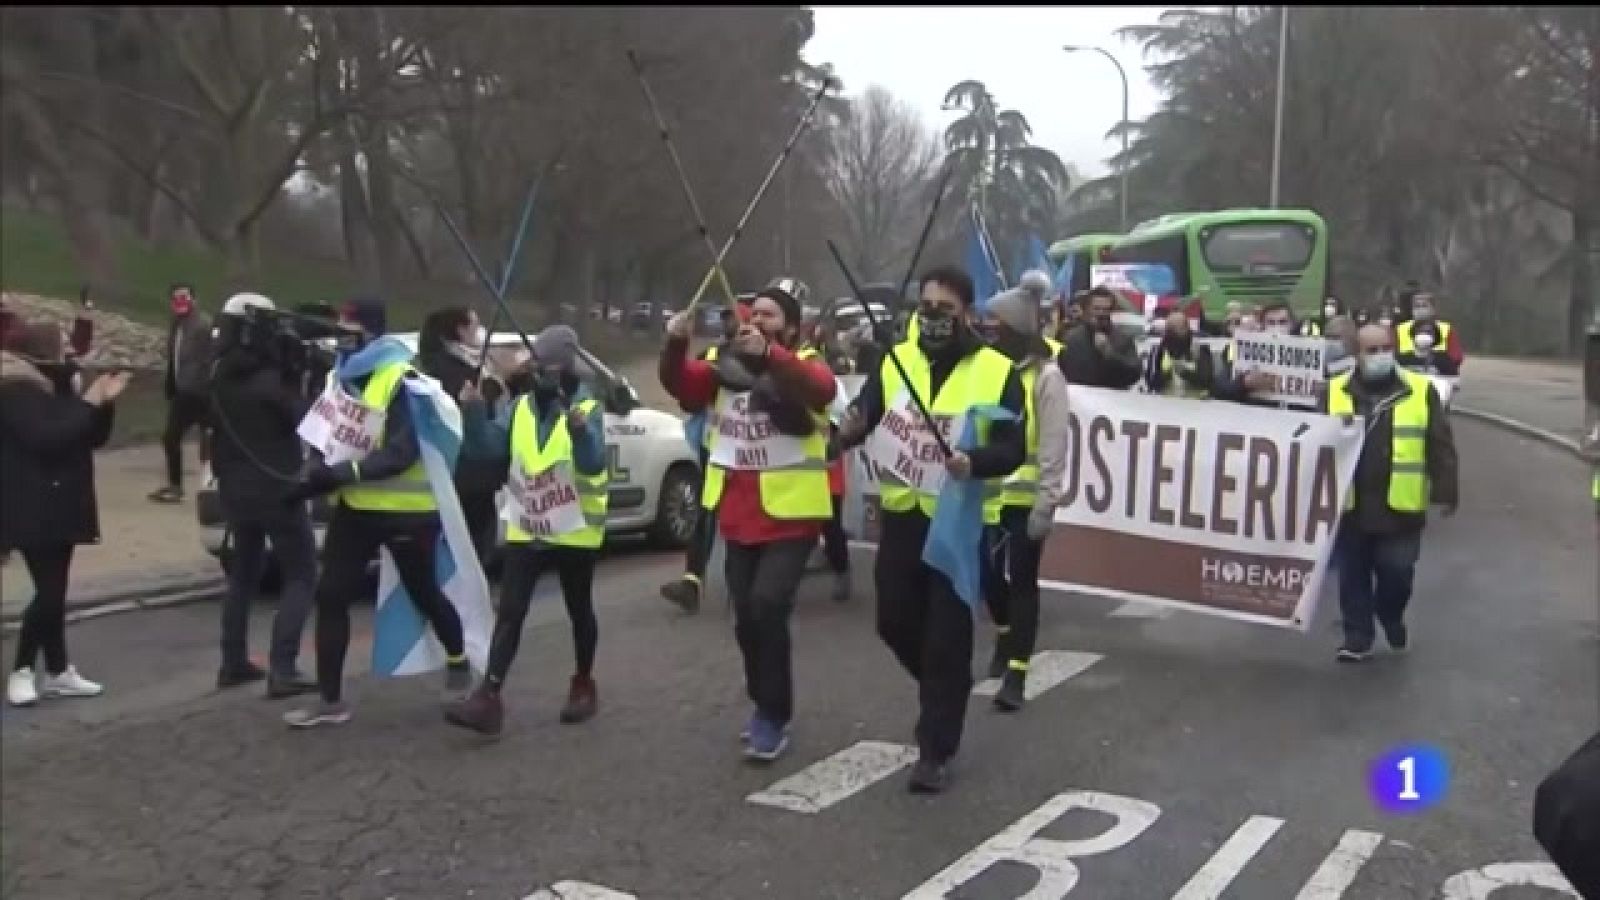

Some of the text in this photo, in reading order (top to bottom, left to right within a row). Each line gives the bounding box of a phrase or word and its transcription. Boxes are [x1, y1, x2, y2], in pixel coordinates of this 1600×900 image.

[1237, 339, 1321, 371] TODOS SOMOS
[1053, 412, 1338, 546] OSTELERÍA
[898, 789, 1585, 900] BU
